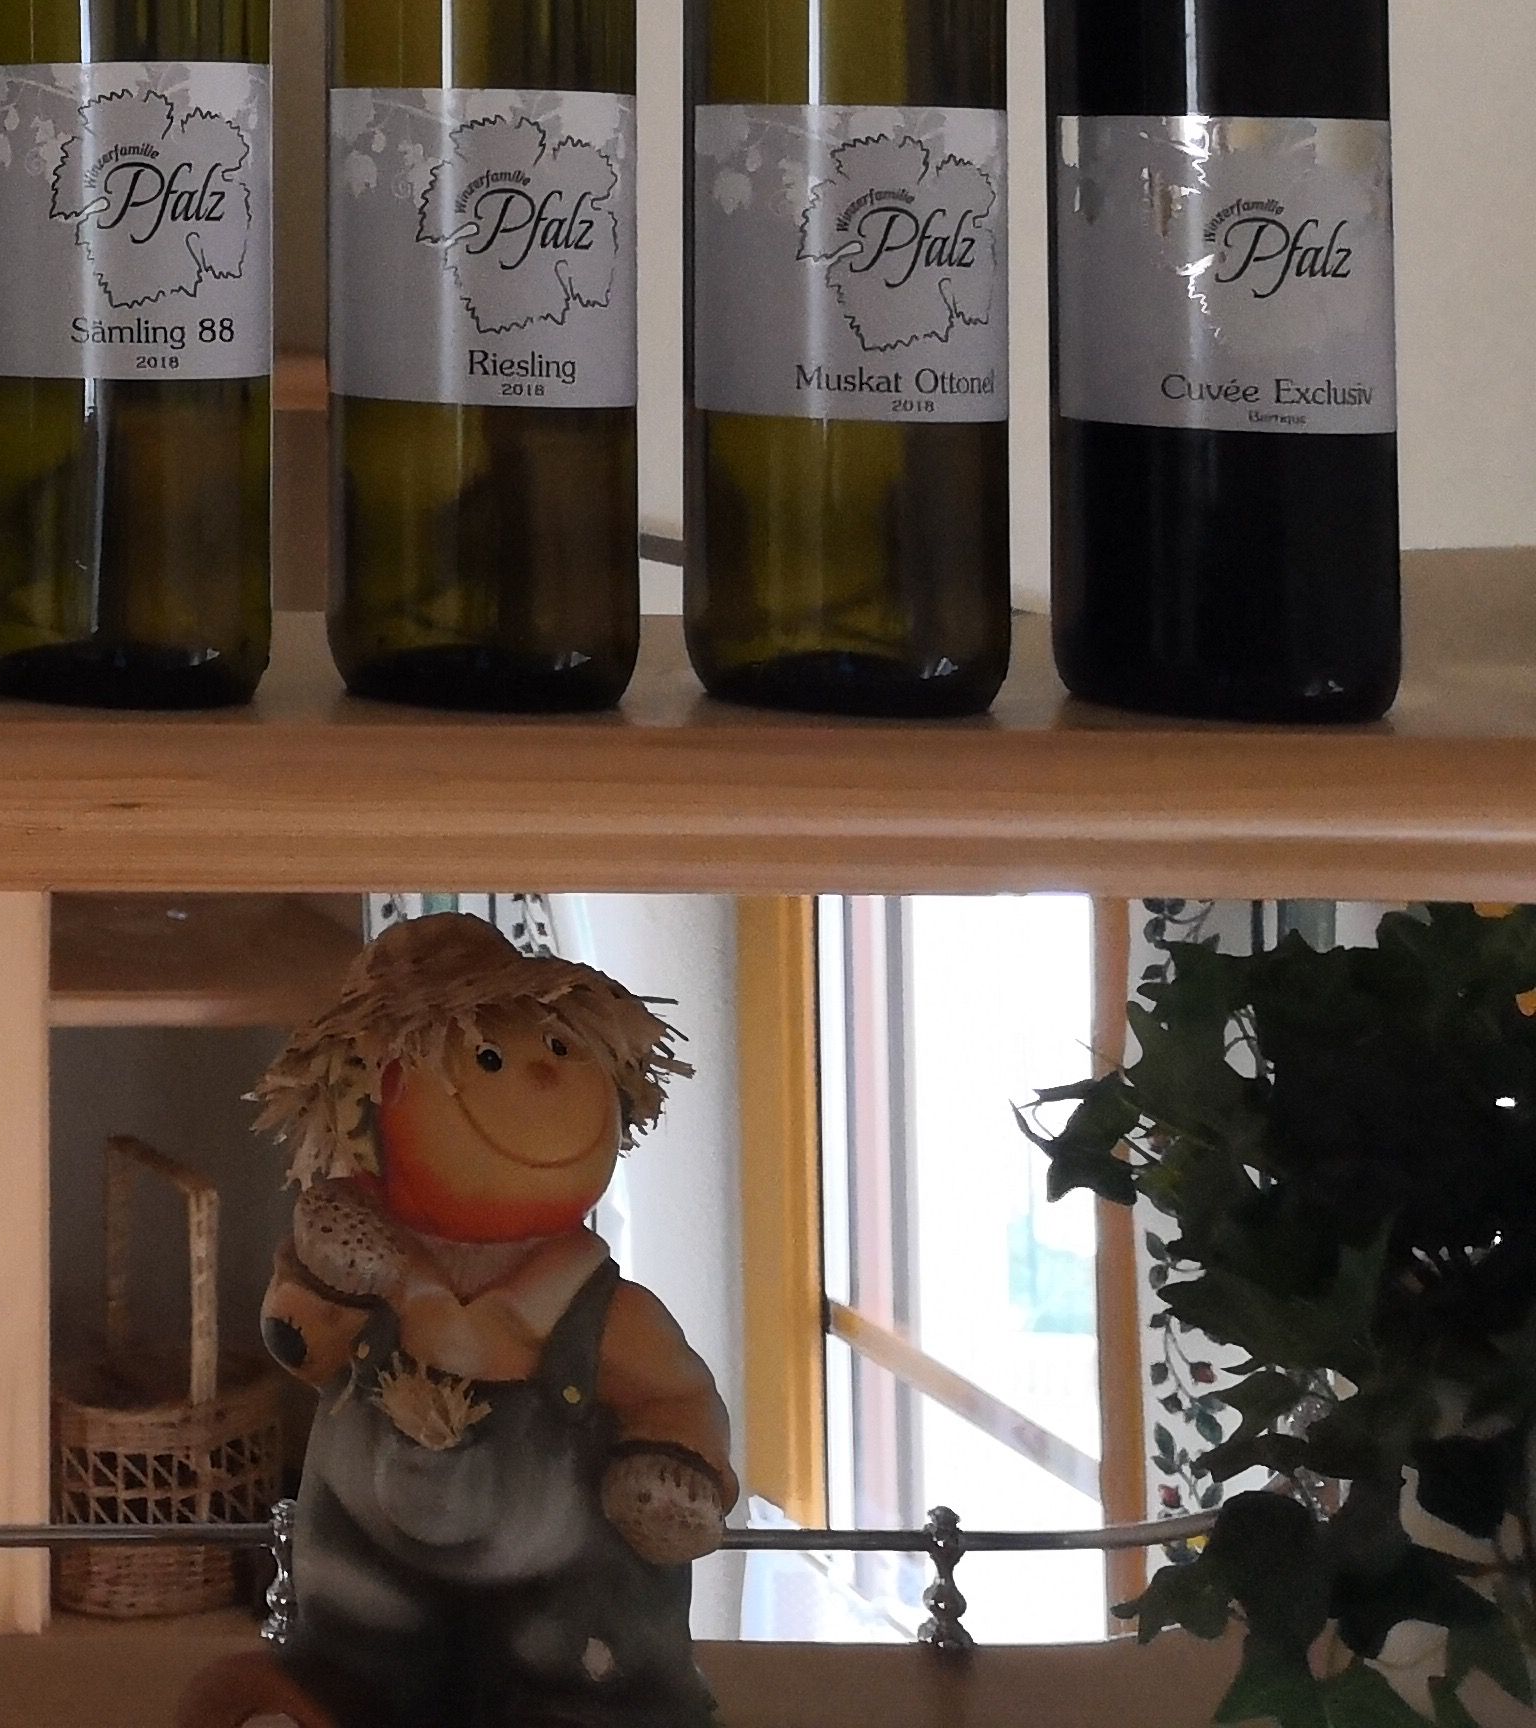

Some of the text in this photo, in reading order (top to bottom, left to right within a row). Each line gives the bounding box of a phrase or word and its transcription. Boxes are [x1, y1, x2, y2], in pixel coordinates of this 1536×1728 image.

[97, 161, 226, 244] Pfalz
[454, 169, 532, 214] Winzerfamilie
[465, 187, 594, 270] Pfalz
[849, 206, 976, 289] Pfalz
[1215, 216, 1353, 299] Pfalz
[71, 317, 235, 349] Sämling 88
[136, 355, 180, 369] 2018
[467, 349, 576, 385] Riesling
[501, 383, 545, 396] 2018
[796, 365, 995, 394] Muskat Ottonel
[1161, 374, 1373, 406] Cuvée Exclusiv
[892, 400, 934, 412] 2018
